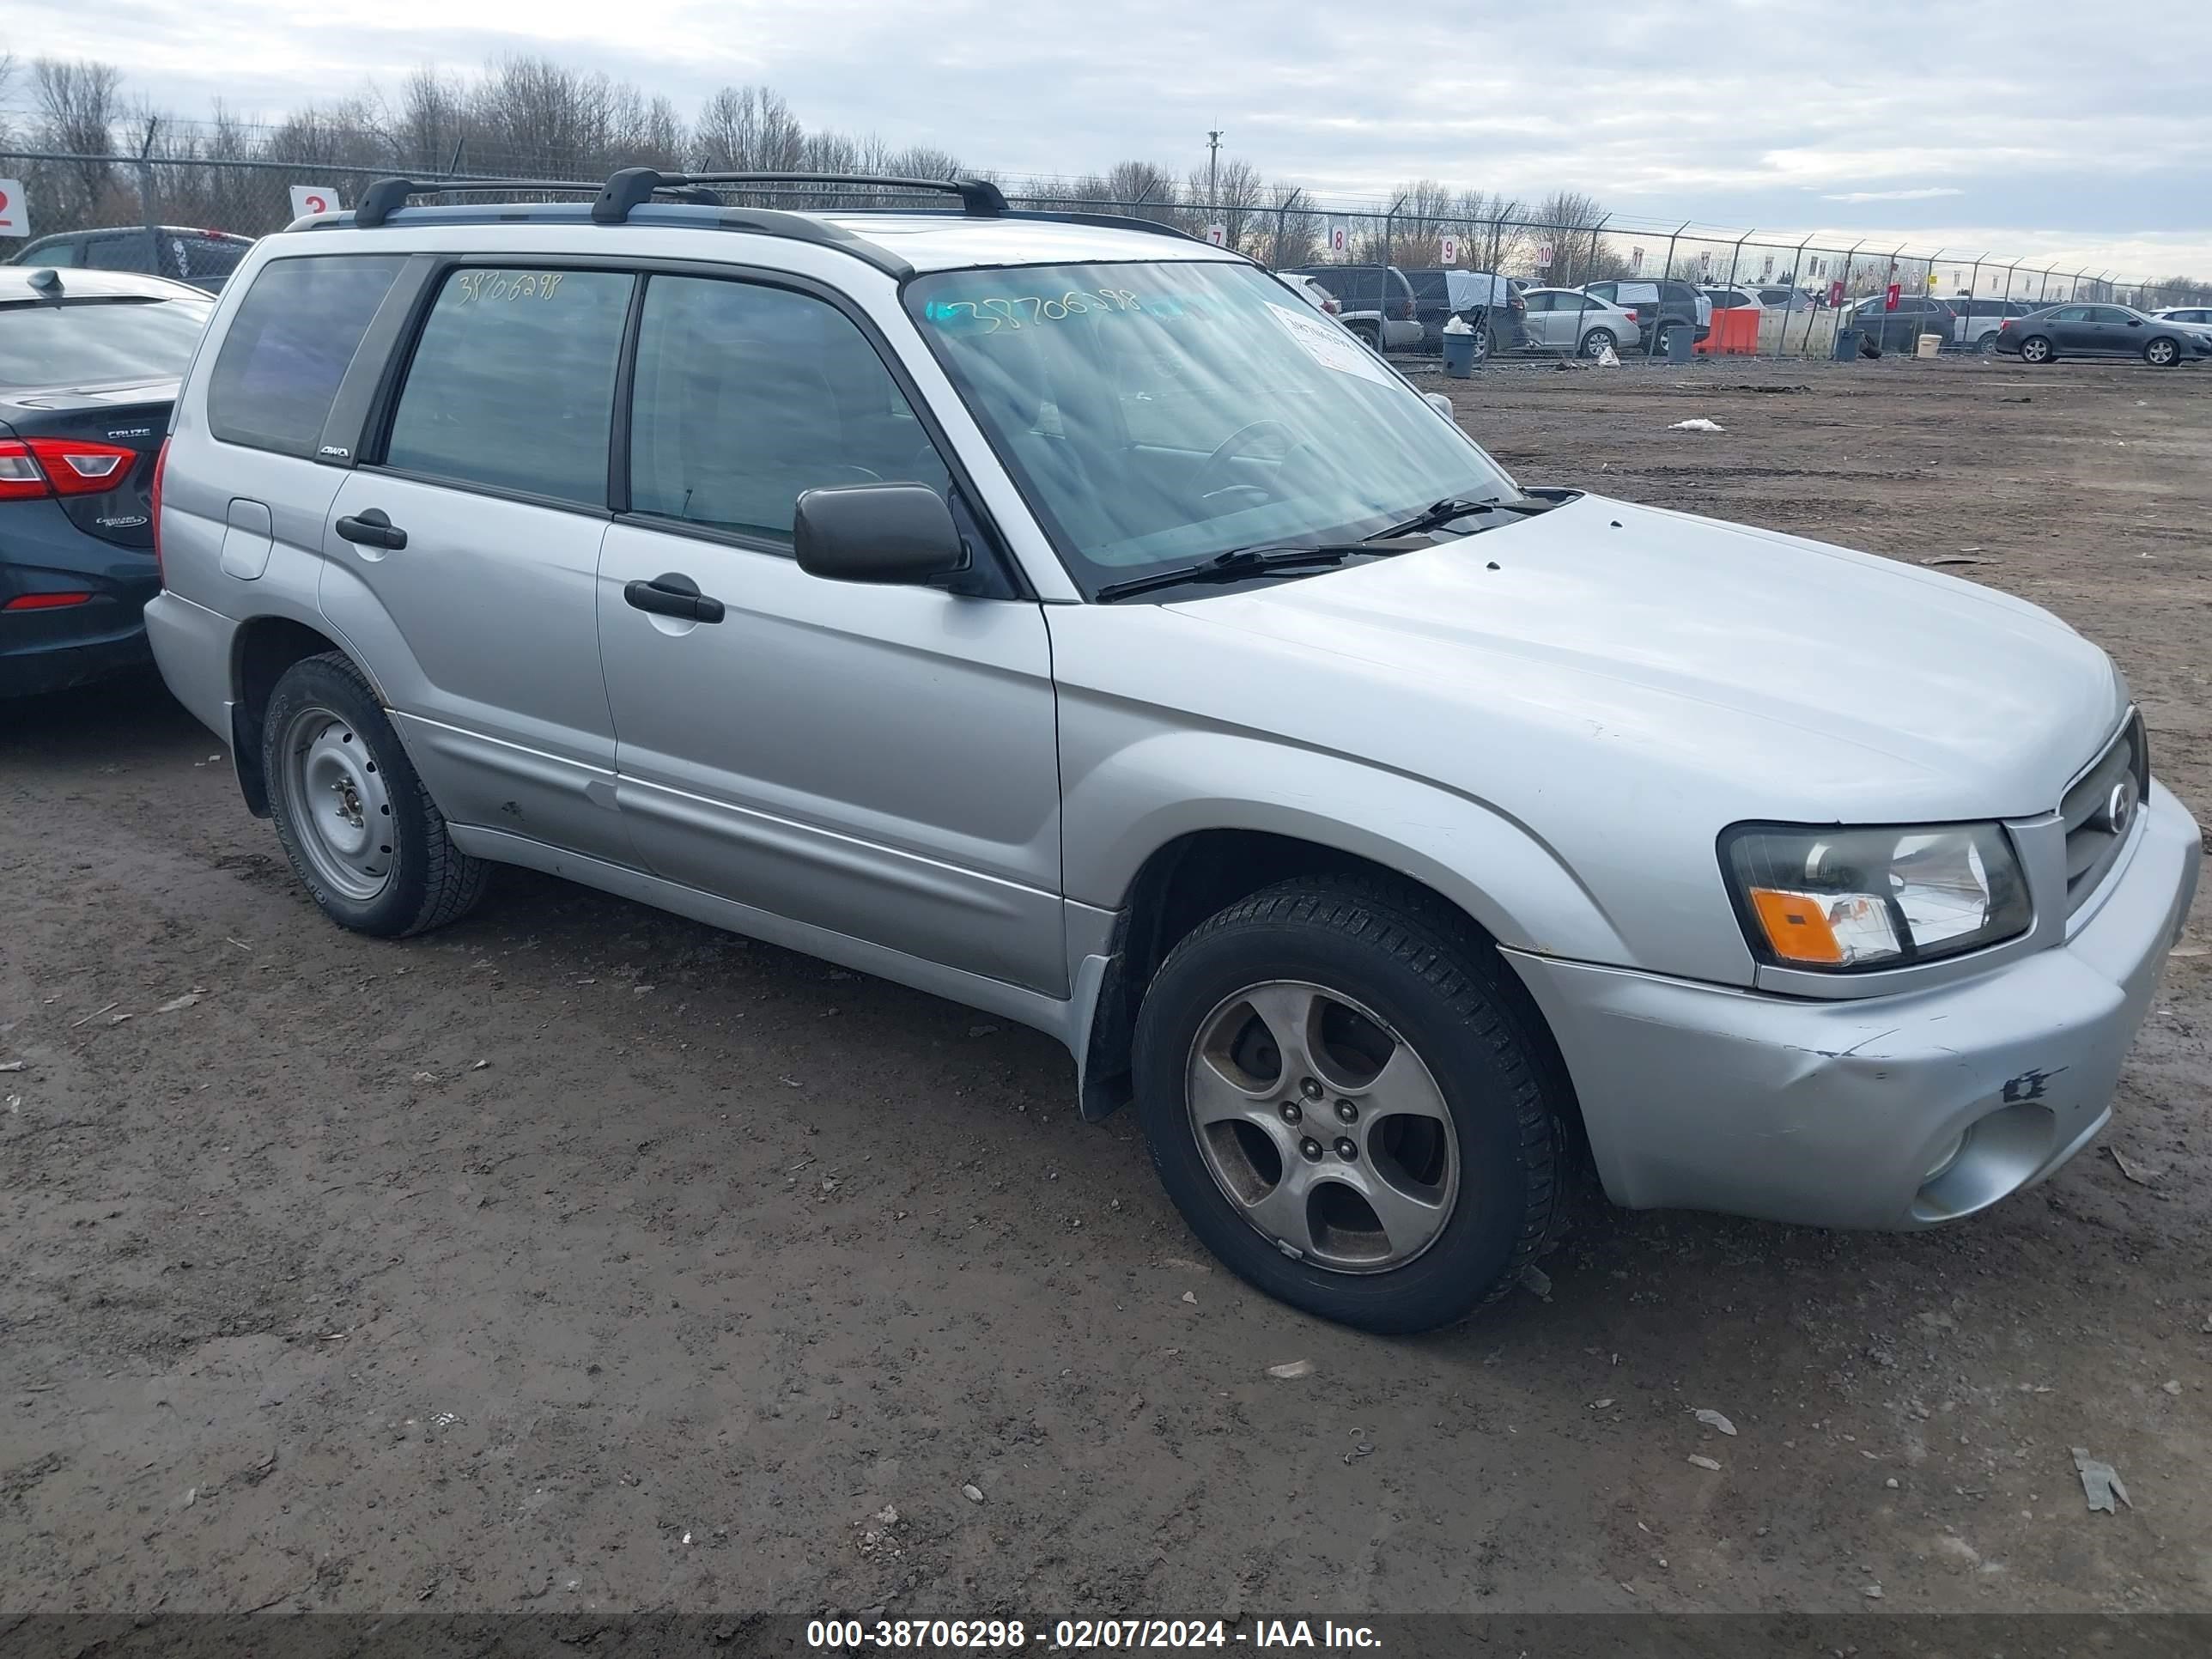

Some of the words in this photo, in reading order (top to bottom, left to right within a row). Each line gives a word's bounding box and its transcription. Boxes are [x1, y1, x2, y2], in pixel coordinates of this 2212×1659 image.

[1212, 231, 1221, 245] 7
[1335, 230, 1343, 251] 8
[1445, 240, 1453, 259] 9
[1540, 246, 1551, 263] 10
[1633, 251, 1643, 268] 11
[1701, 255, 1710, 270] 12
[458, 271, 563, 309] 38706298
[947, 289, 1141, 335] 38706298
[107, 428, 151, 439] CRUZE
[320, 446, 349, 457] AWD
